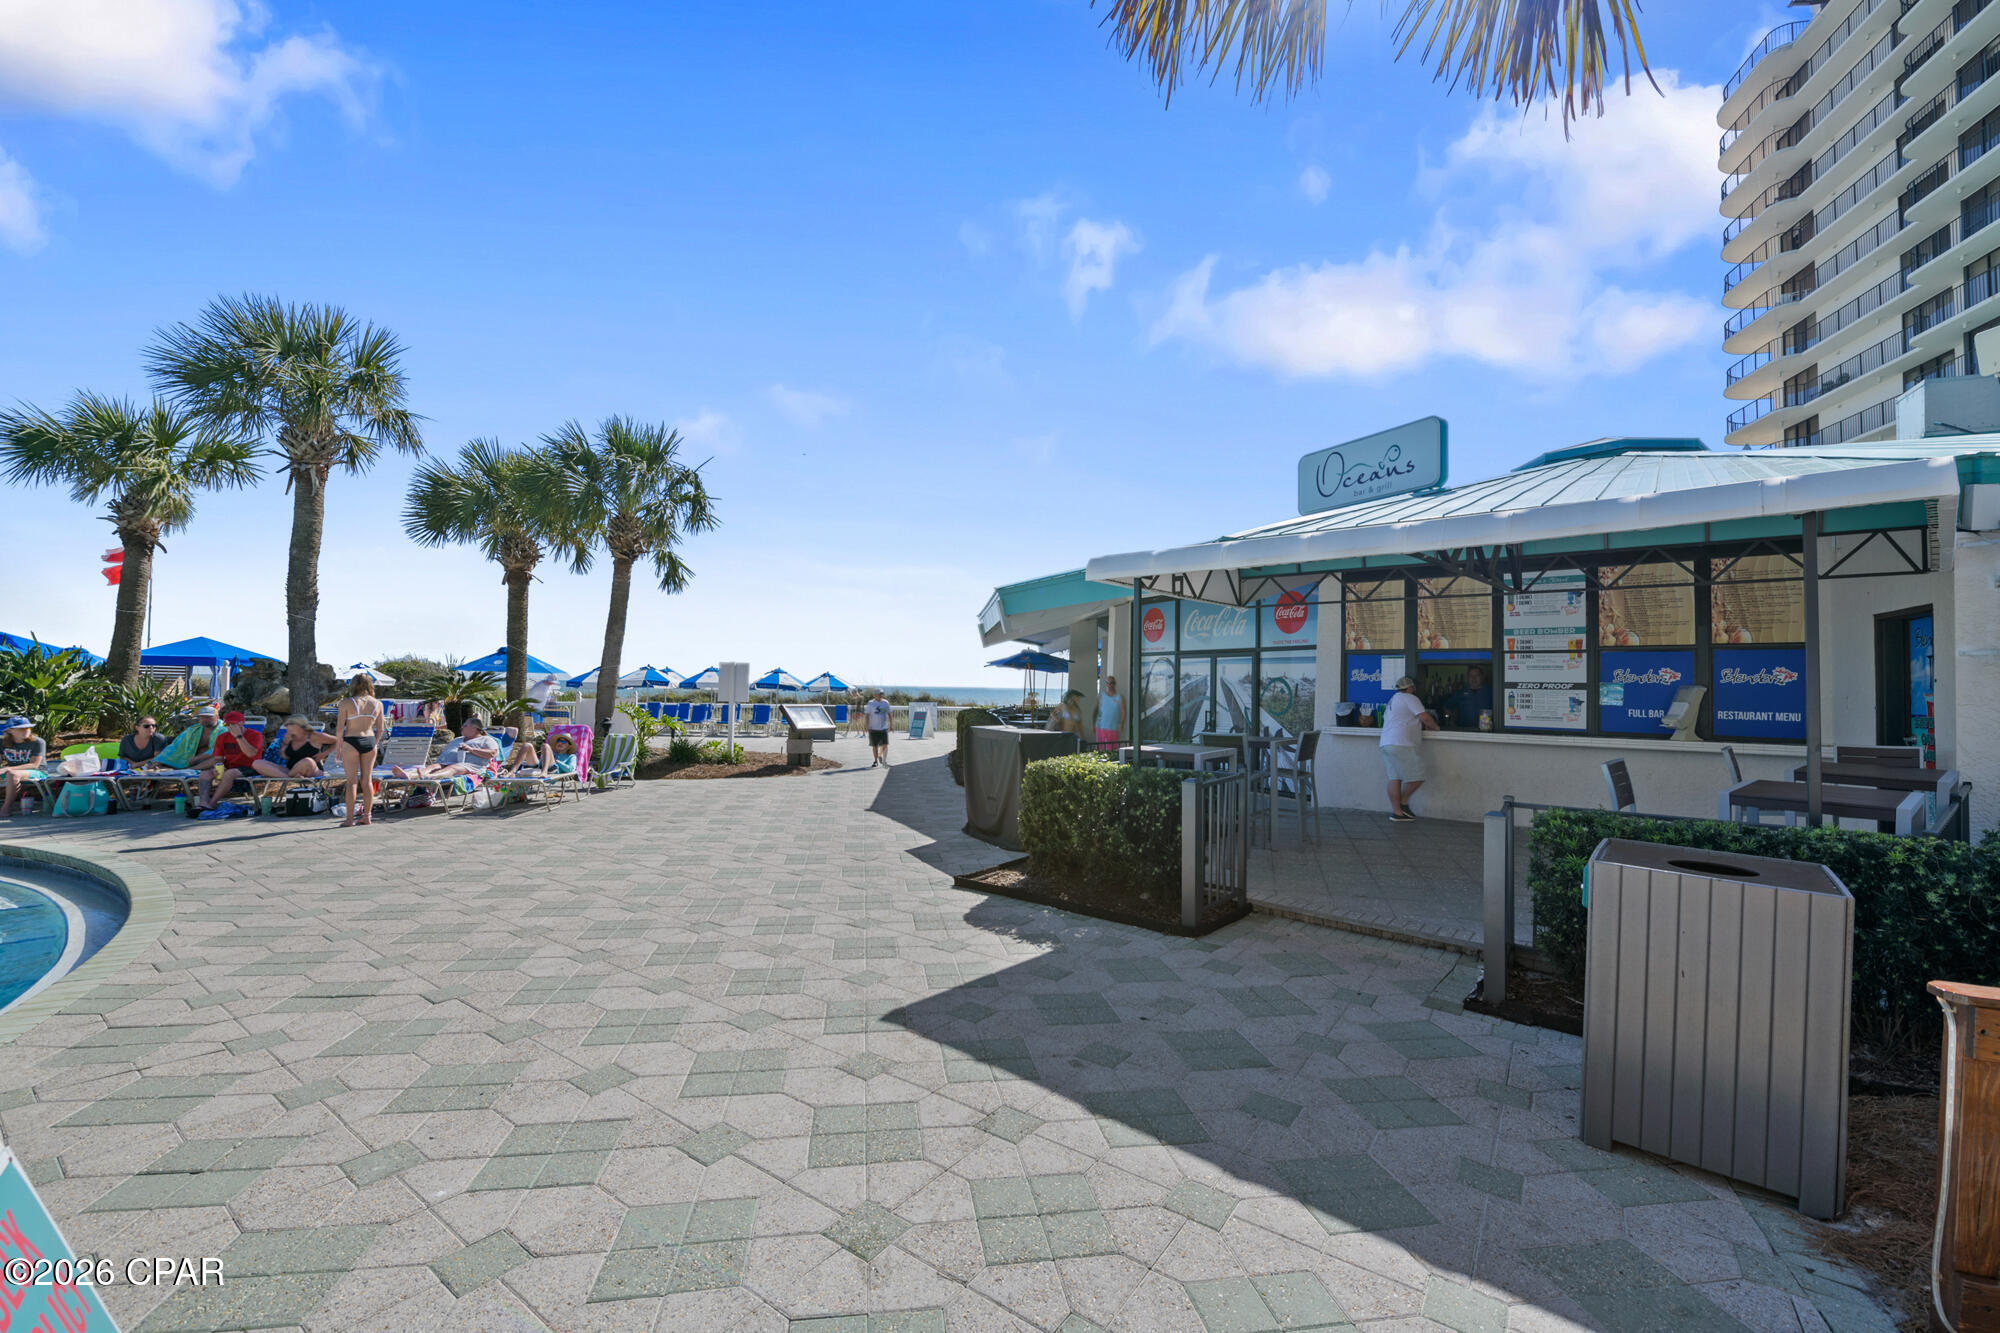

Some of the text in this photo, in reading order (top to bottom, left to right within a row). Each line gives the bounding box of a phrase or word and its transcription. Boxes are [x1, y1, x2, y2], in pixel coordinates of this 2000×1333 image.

[1316, 444, 1415, 497] Oceans
[1353, 482, 1392, 497] bar & grill
[1513, 628, 1536, 636] BEER
[1516, 682, 1540, 690] ZERO
[1628, 709, 1665, 718] FULL BAR
[1717, 710, 1802, 722] RESTAURANT MENU
